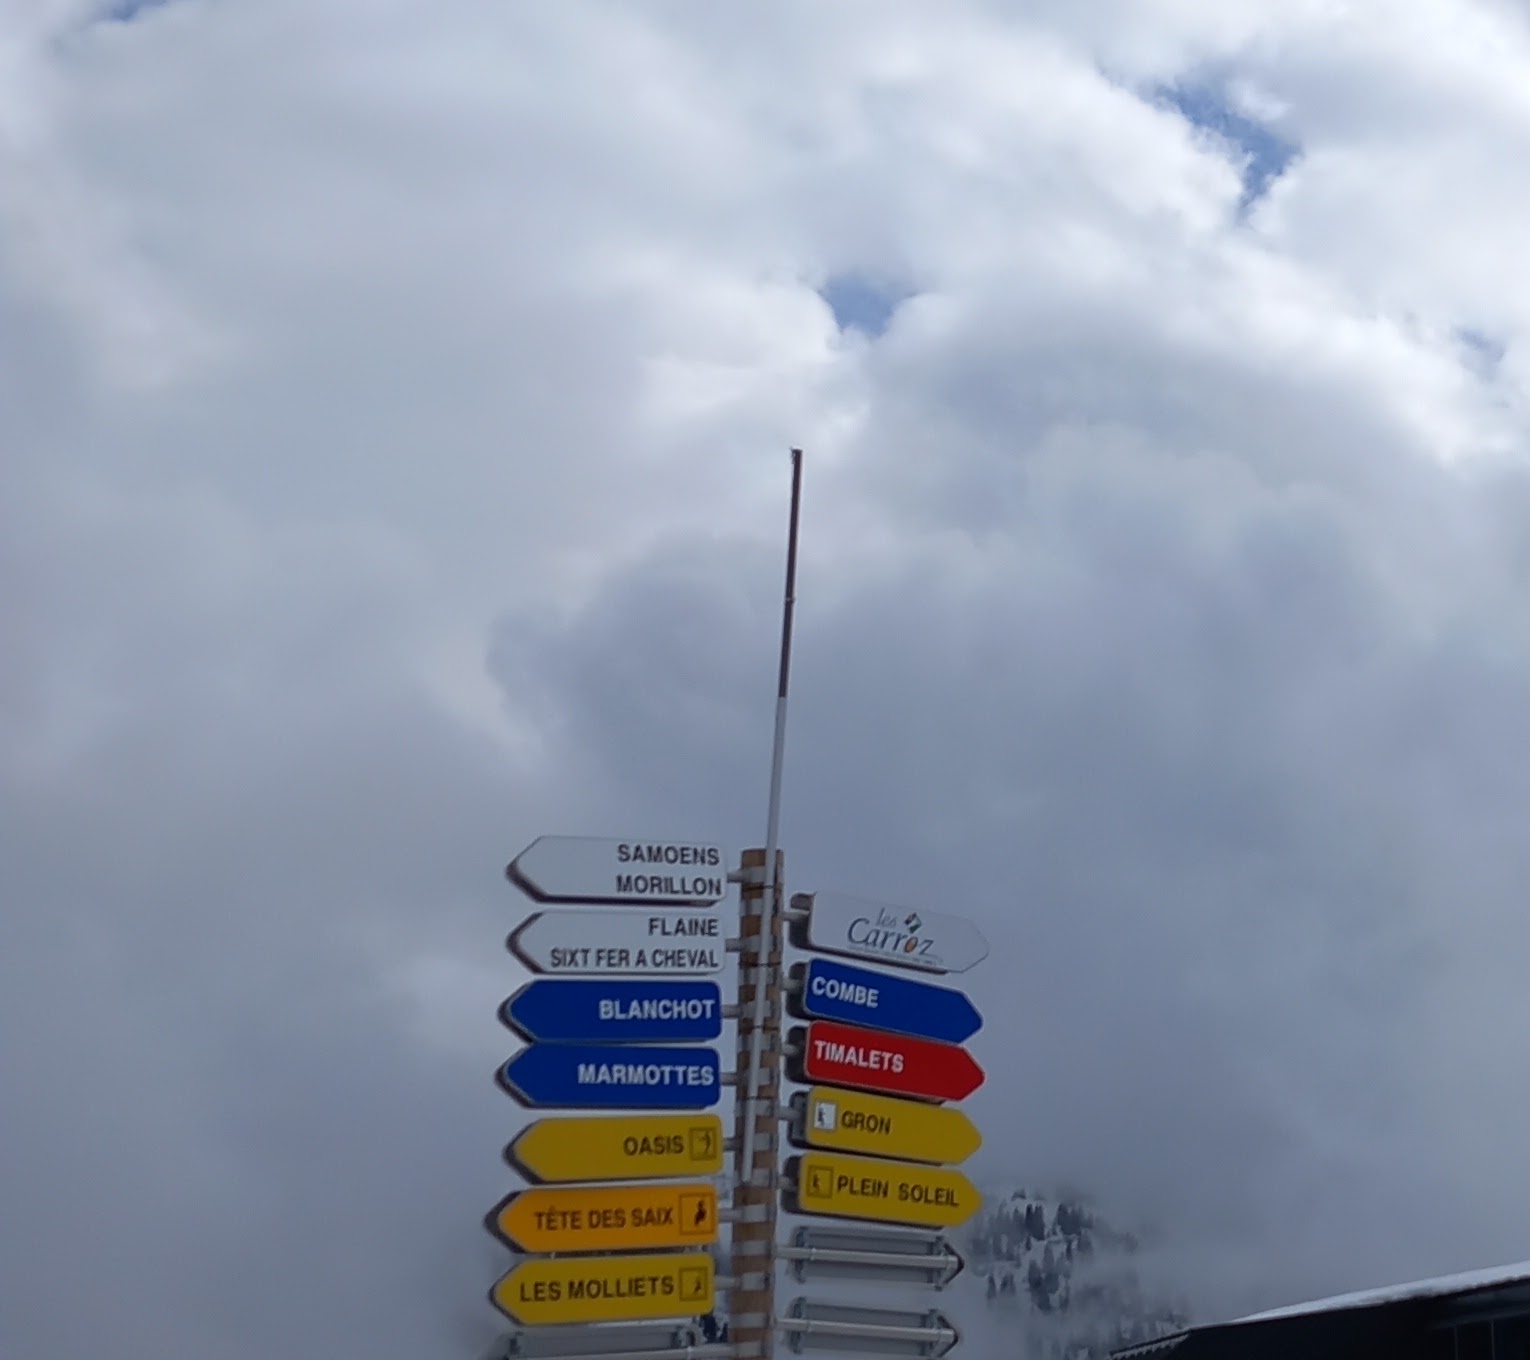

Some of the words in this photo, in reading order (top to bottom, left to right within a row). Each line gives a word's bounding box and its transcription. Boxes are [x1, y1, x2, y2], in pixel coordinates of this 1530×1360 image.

[617, 843, 720, 866] SAMOENS
[616, 874, 722, 896] MORILLON
[648, 917, 719, 937] FLAINE
[847, 917, 934, 955] Carroz
[550, 947, 590, 968] SIXT
[595, 948, 630, 968] FER
[635, 949, 648, 968] A
[652, 948, 719, 969] CHEVAL
[811, 976, 880, 1009] COMBE
[599, 999, 715, 1020] BLANCHOT
[814, 1039, 904, 1073] TIMALETS
[577, 1063, 714, 1086] MARMOTTES
[840, 1110, 891, 1135] GRON
[623, 1135, 684, 1156] OASIS
[837, 1174, 889, 1198] PLEIN
[897, 1182, 960, 1207] SOLEIL
[534, 1205, 582, 1231] TÊTE
[588, 1209, 626, 1229] DES
[631, 1206, 674, 1228] SAIX
[520, 1280, 561, 1302] LES
[568, 1276, 674, 1300] MOLLIETS
